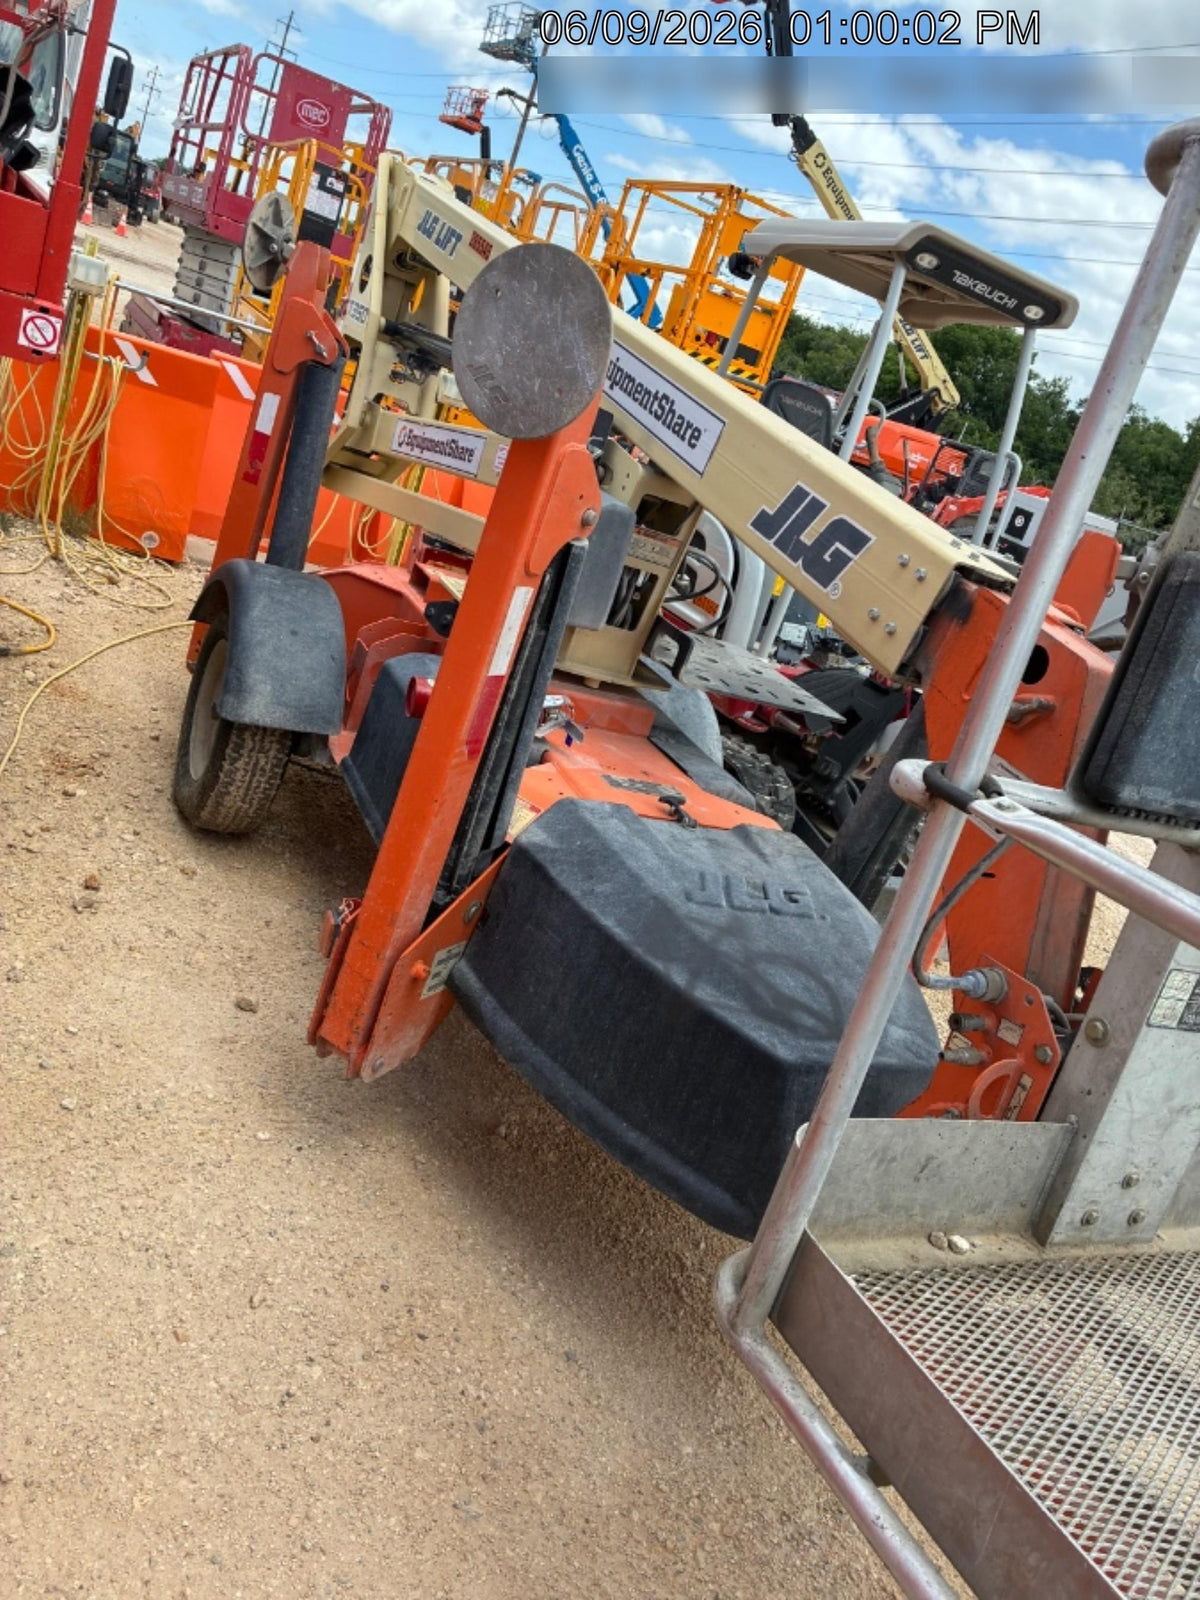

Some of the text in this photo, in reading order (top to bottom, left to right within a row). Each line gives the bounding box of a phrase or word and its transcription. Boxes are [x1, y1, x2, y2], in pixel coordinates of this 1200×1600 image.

[572, 144, 594, 183] Genie
[417, 209, 440, 240] JLG
[433, 221, 463, 257] LIFT
[405, 428, 475, 463] EquipmentShare
[748, 481, 876, 592] JLG
